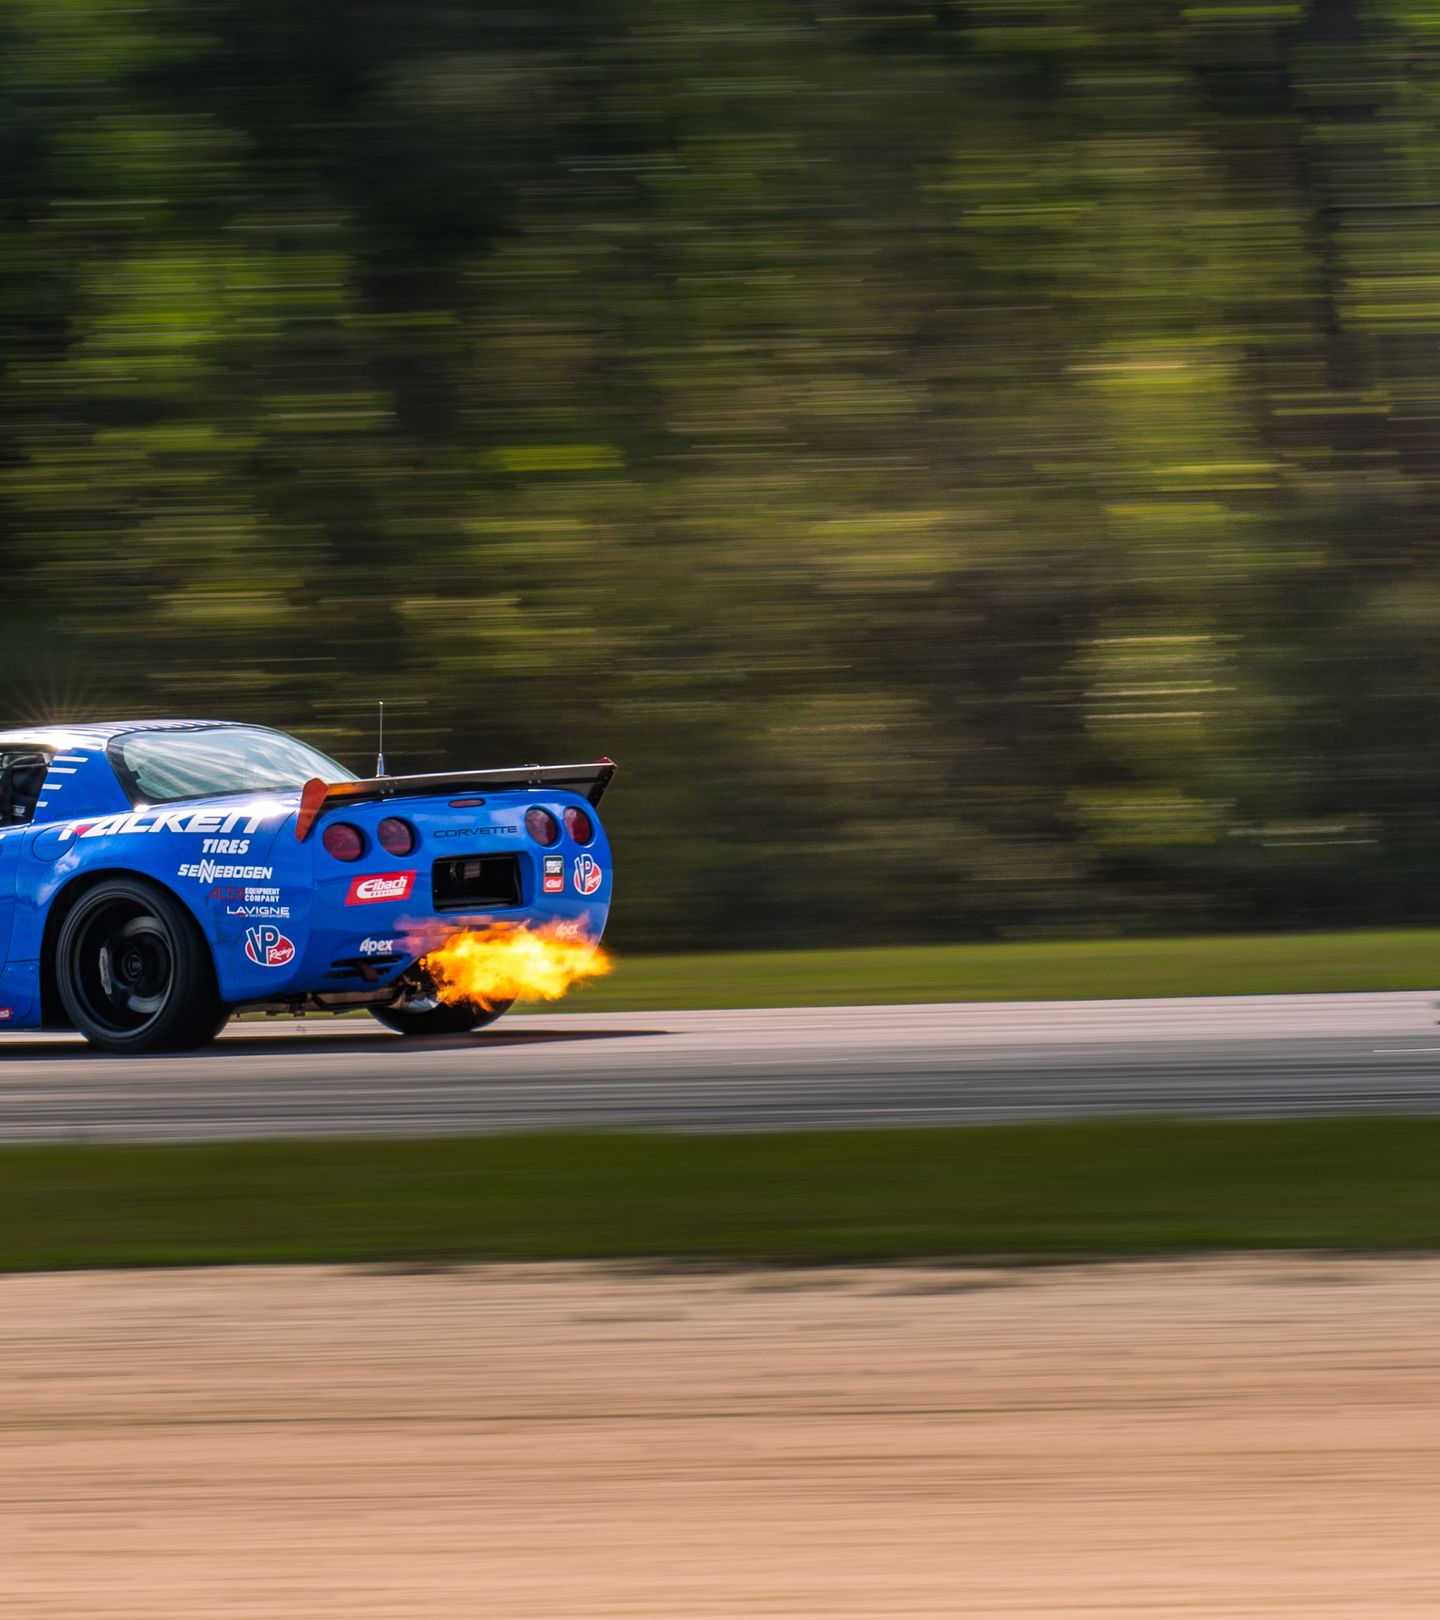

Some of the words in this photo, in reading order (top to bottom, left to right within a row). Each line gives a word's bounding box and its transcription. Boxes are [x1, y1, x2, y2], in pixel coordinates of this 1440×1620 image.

[58, 811, 263, 841] FALKEN
[433, 825, 518, 838] CORVETTE
[202, 838, 250, 854] TIRES
[574, 854, 594, 892] VP
[245, 887, 280, 895] EQUIPMENT
[358, 876, 408, 898] Eibach
[245, 895, 280, 903] COMPANY
[227, 905, 290, 915] LAVIGNE
[245, 925, 280, 965] VP
[360, 937, 394, 955] Apex
